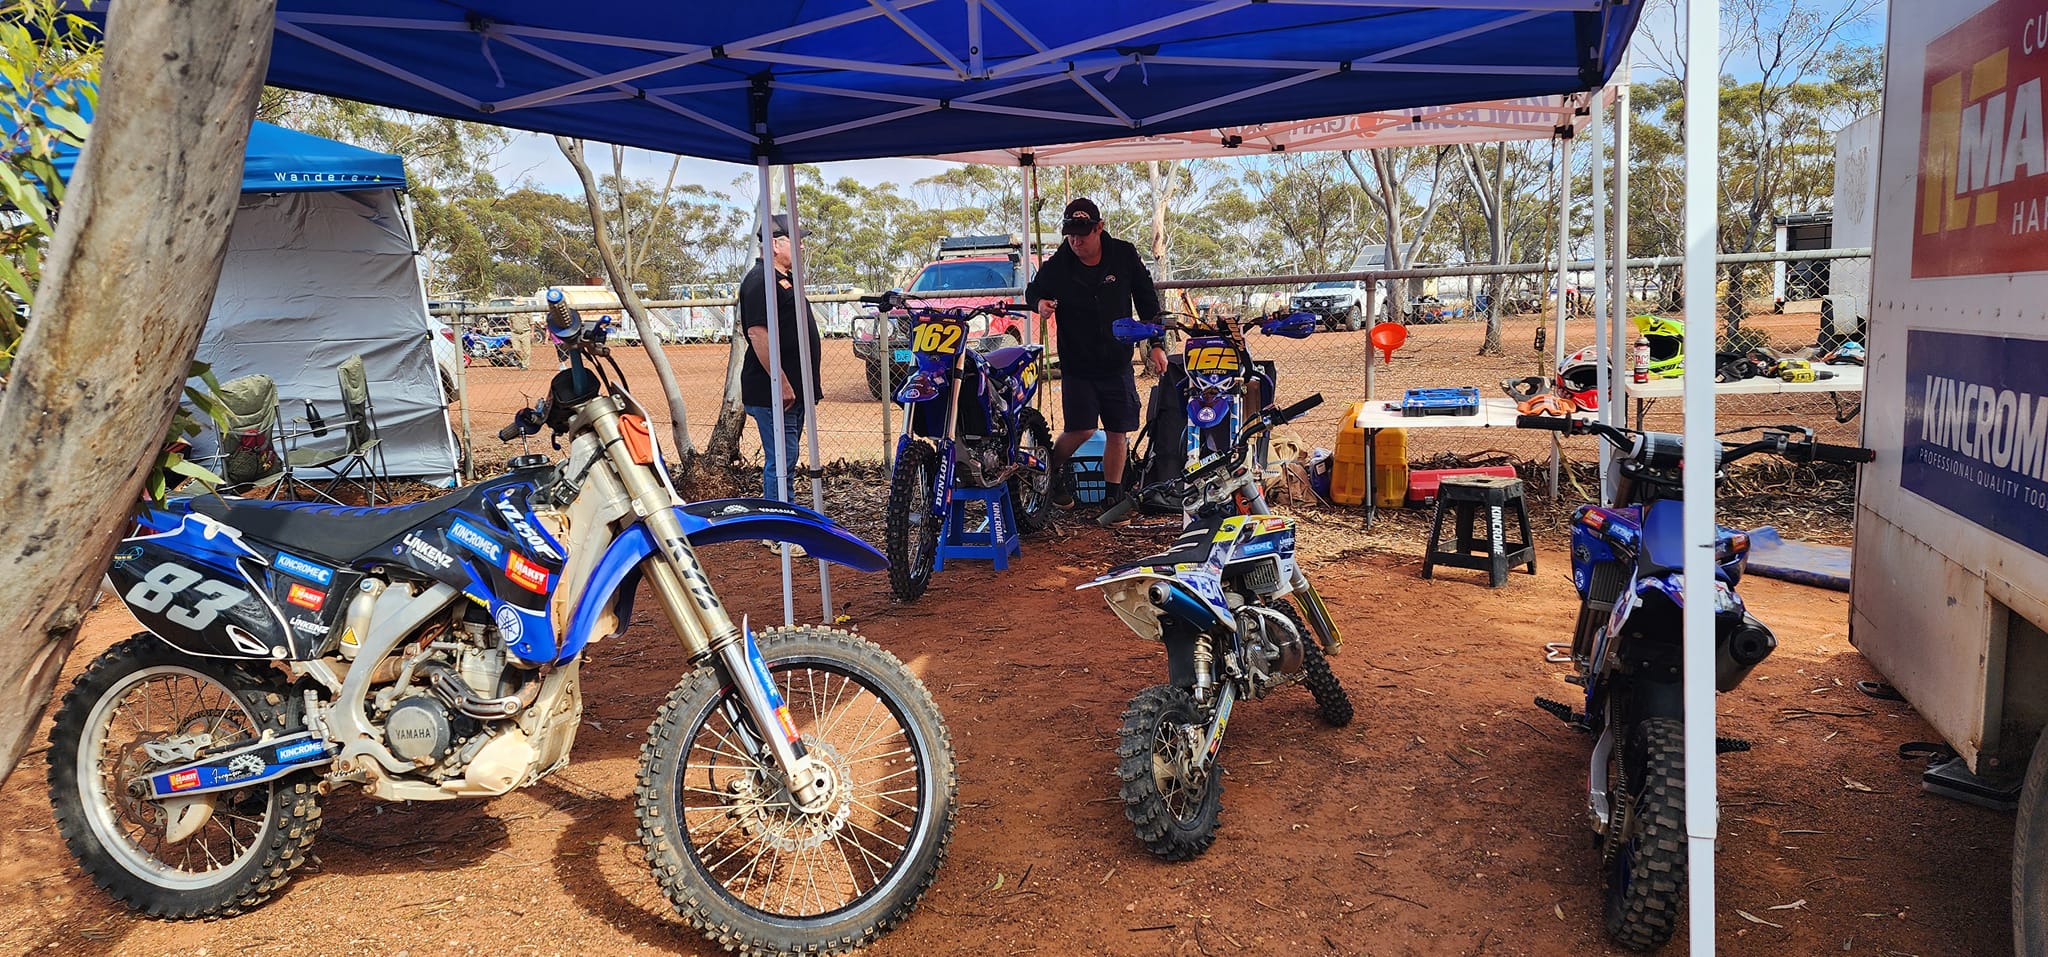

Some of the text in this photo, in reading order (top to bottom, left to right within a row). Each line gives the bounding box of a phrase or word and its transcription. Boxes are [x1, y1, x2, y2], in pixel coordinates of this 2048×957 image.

[1957, 77, 2048, 195] MA
[912, 323, 962, 354] 162
[1020, 362, 1039, 389] 162
[1187, 347, 1239, 371] 162
[1921, 374, 2048, 483] KINCROM
[935, 455, 948, 507] DUNLOP
[1919, 448, 2048, 512] PROFESSIONAL QUALITY TOO
[451, 522, 493, 552] KINCROME
[992, 502, 1004, 544] KINCROME
[1491, 505, 1504, 556] KINCROME
[278, 556, 320, 578] KINCROME
[403, 533, 454, 568] LINKENZ
[515, 560, 547, 582] MAKIT
[665, 537, 720, 610] KYB
[125, 562, 250, 631] 83
[289, 616, 331, 635] LINKENZ
[279, 741, 322, 759] KINCROME
[395, 727, 431, 740] YAMAHA
